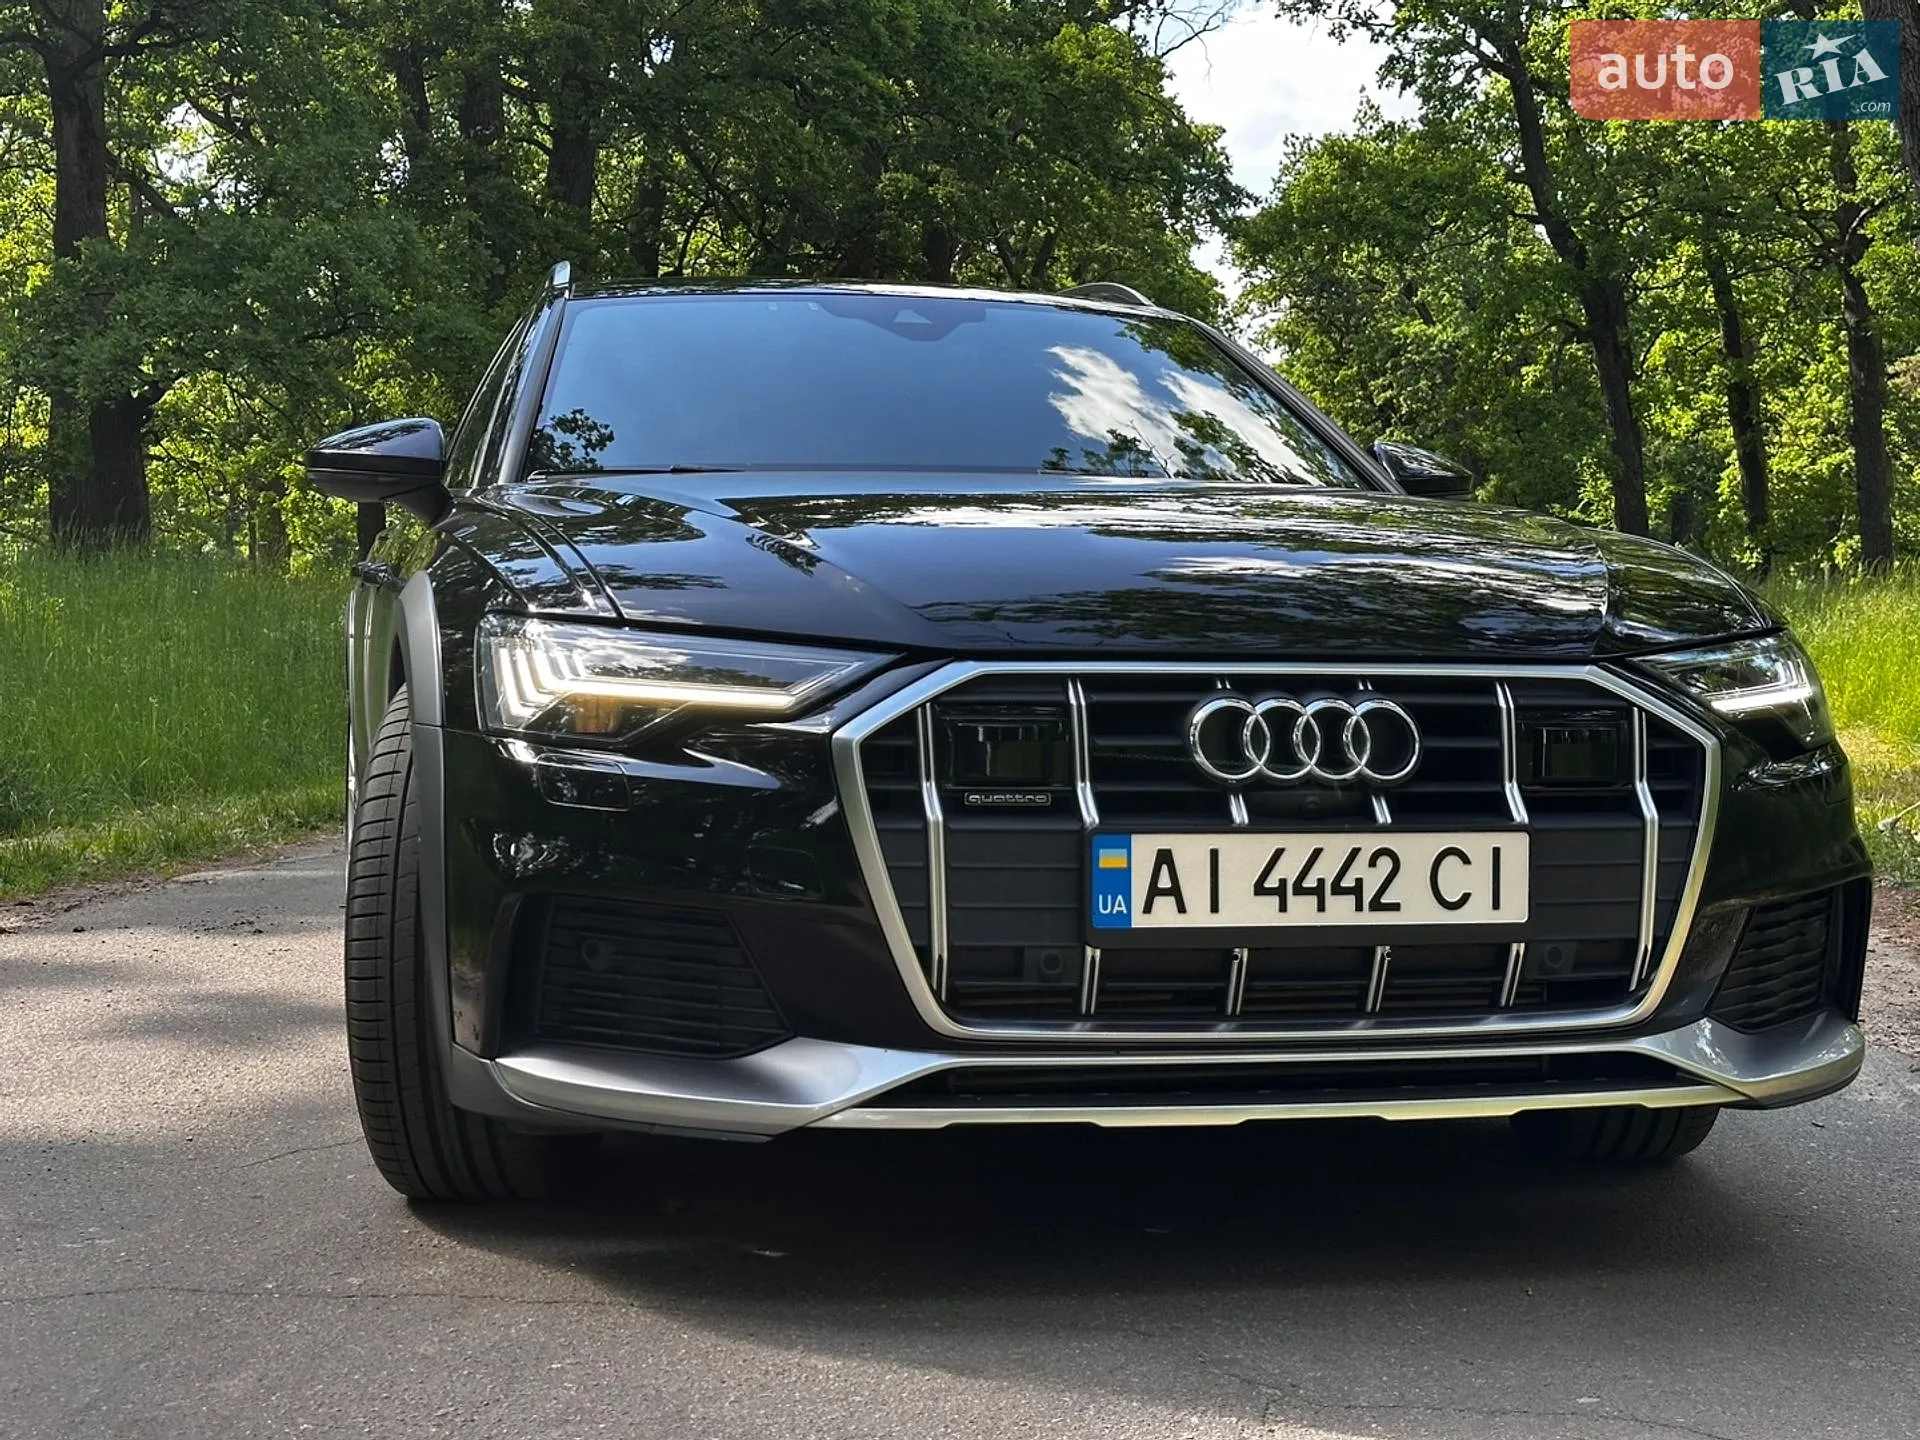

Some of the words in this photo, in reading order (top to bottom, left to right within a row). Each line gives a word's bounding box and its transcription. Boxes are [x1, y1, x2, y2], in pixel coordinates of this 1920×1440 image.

[968, 794, 1048, 804] quattro
[1141, 847, 1220, 915] AI
[1252, 846, 1402, 914] 4442
[1429, 846, 1502, 912] CI
[1098, 894, 1128, 915] UA
